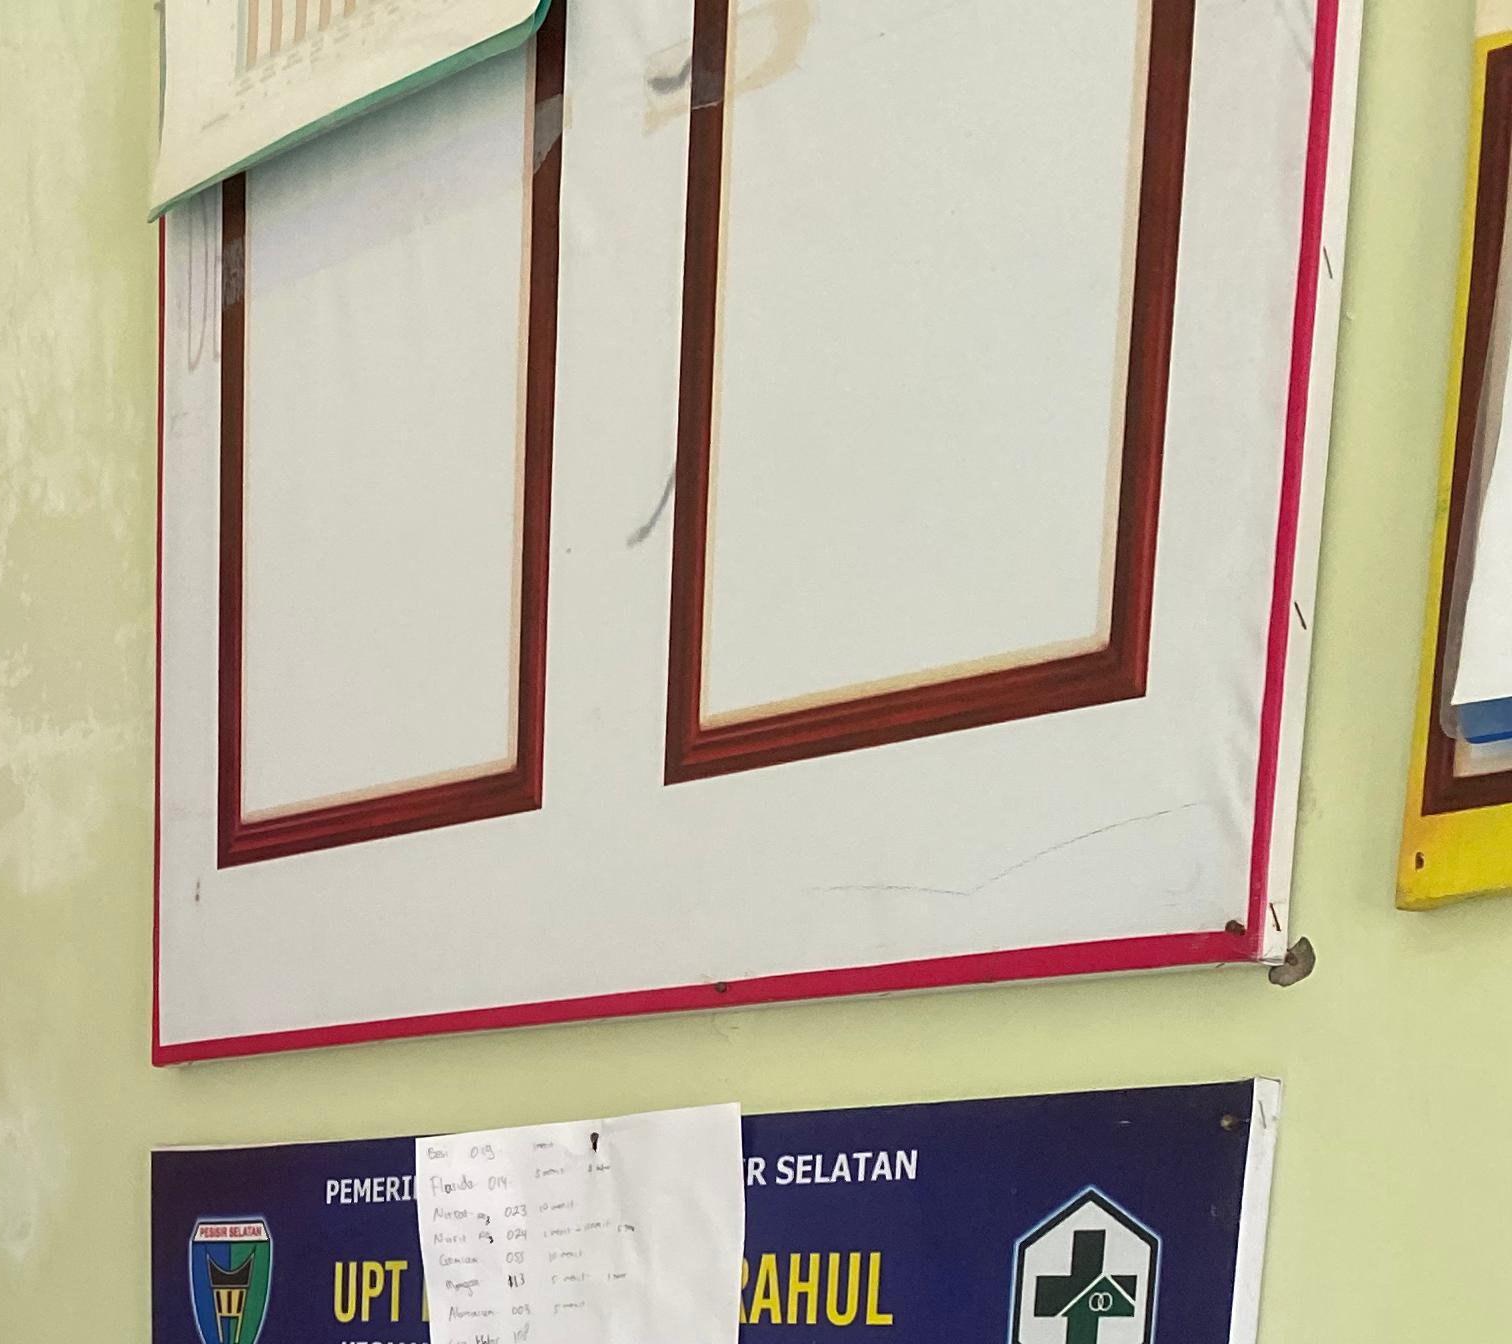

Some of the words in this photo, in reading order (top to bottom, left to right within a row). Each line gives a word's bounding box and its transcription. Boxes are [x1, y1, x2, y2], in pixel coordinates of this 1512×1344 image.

[326, 1175, 414, 1204] PEMERI
[775, 1150, 918, 1185] SELATAN
[229, 1223, 262, 1238] SELATAN
[333, 1260, 408, 1322] UPT
